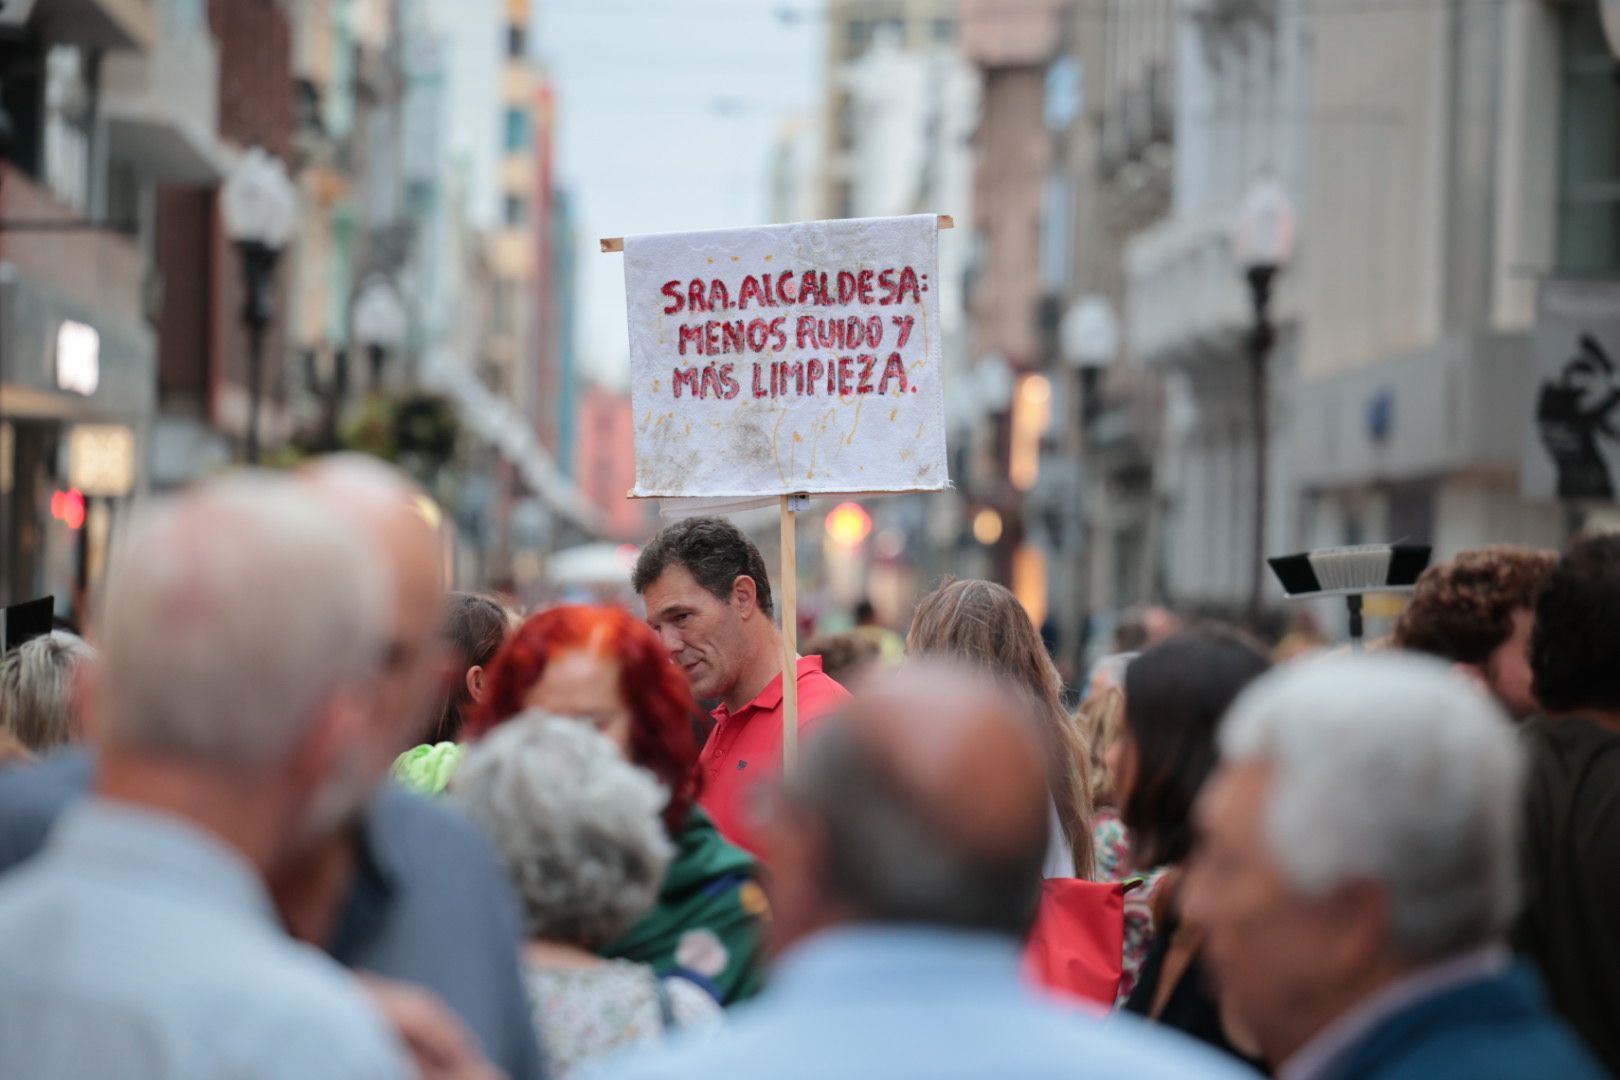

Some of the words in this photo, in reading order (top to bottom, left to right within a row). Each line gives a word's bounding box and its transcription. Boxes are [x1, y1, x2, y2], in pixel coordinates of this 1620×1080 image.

[679, 317, 787, 355] MENOS
[796, 315, 883, 350] RUIDO
[892, 315, 914, 349] Y
[752, 352, 917, 398] LIMPIEZA.
